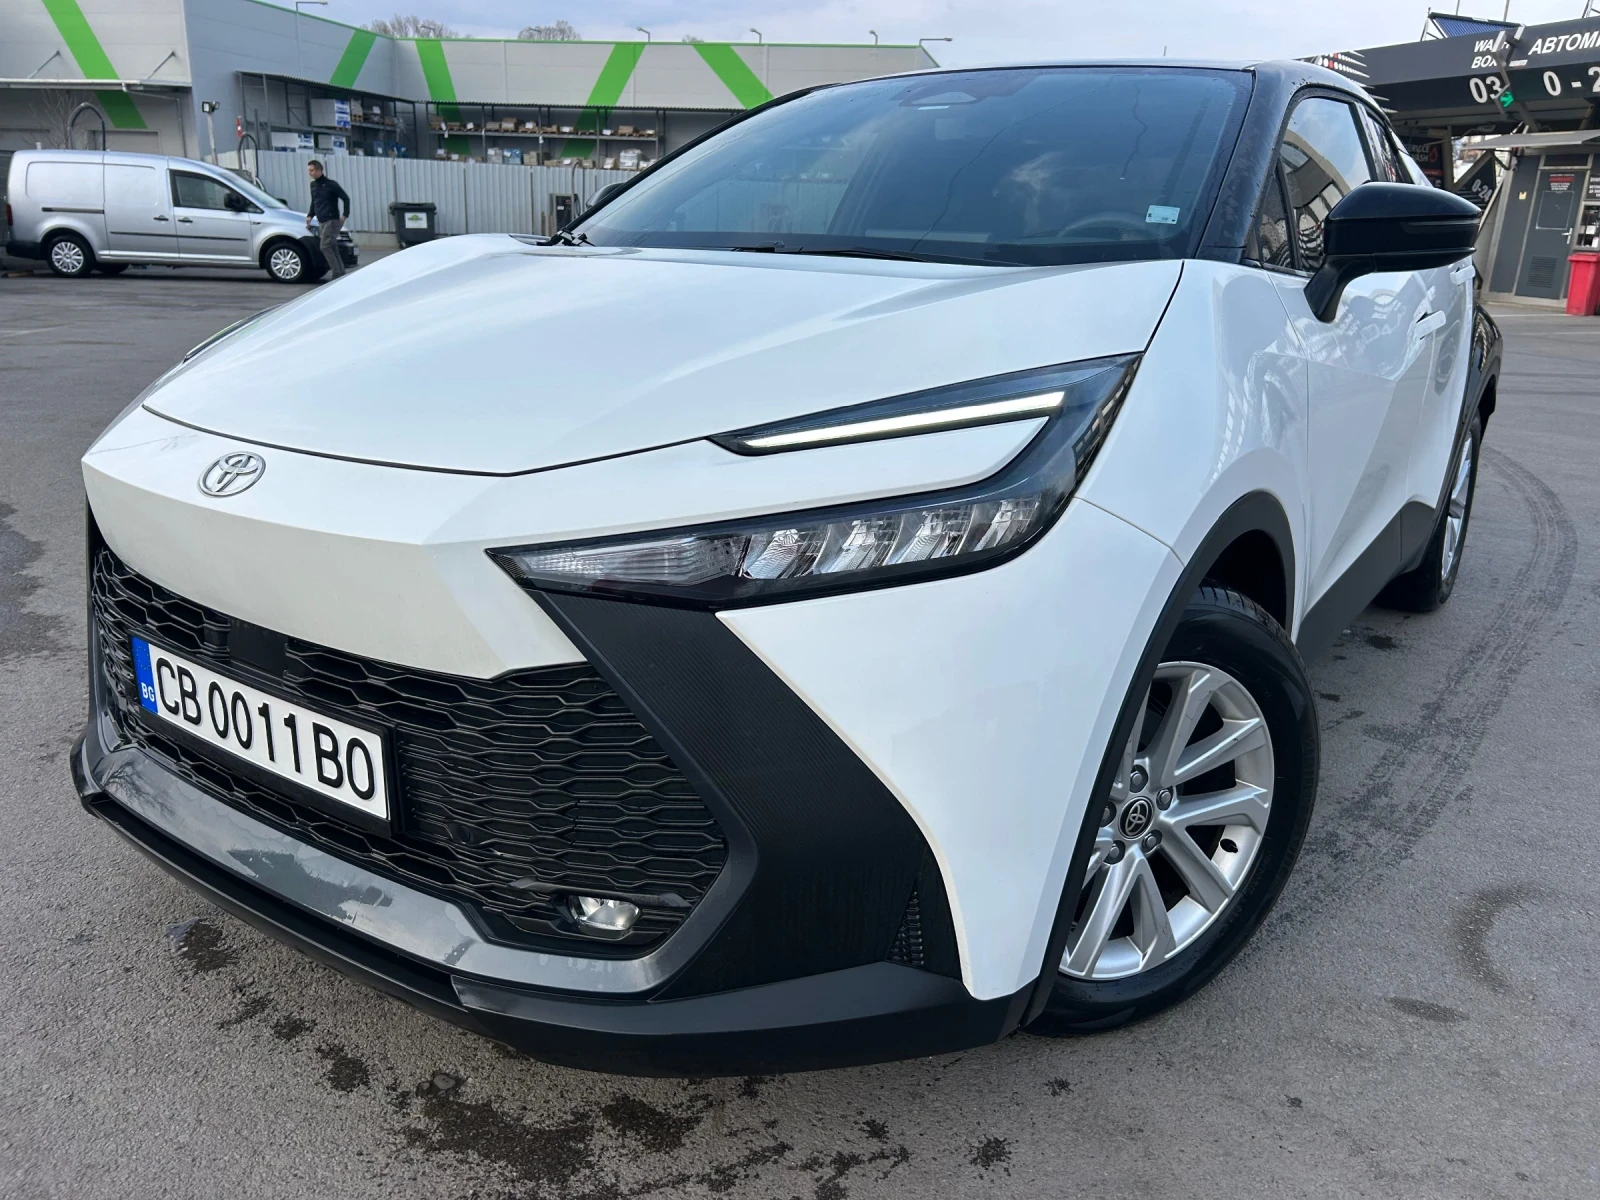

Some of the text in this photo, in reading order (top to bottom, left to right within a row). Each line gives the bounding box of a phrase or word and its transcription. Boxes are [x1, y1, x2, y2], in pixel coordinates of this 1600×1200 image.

[1474, 38, 1510, 53] WAH
[1469, 76, 1503, 104] 03
[1472, 179, 1493, 202] 0-24
[141, 682, 155, 703] BG
